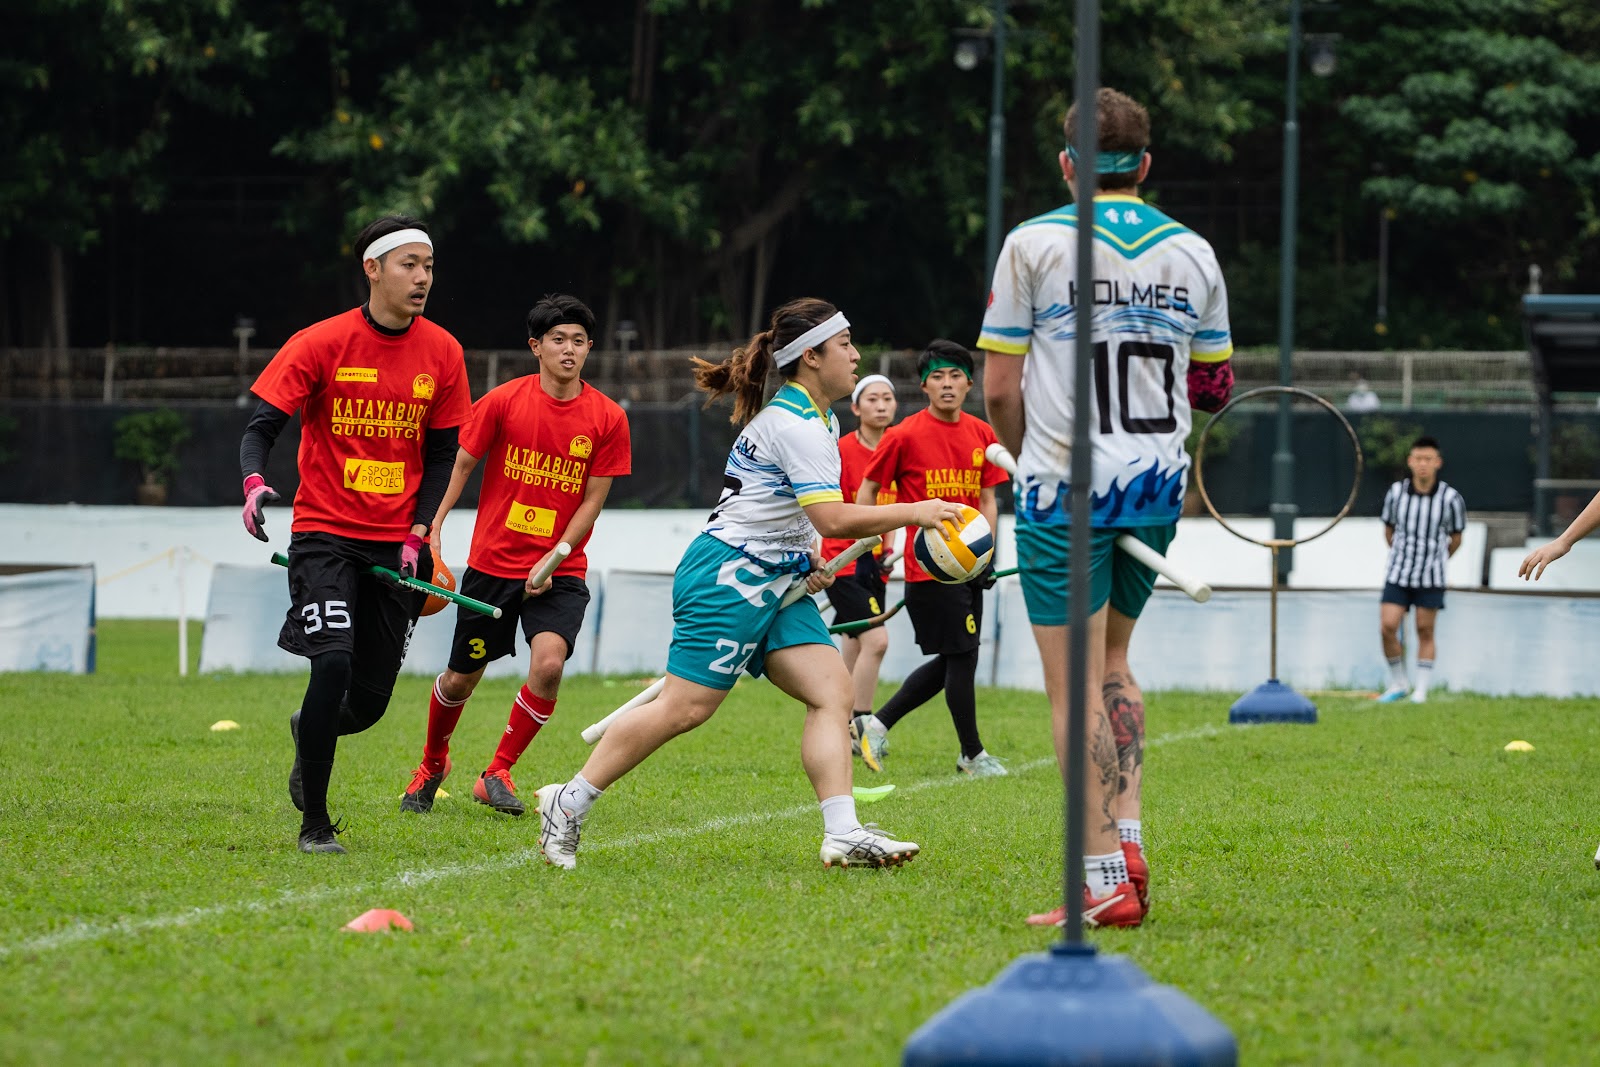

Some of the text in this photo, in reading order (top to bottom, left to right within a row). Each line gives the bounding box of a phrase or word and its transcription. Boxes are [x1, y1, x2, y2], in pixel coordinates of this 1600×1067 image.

[1104, 208, 1143, 225] 香港
[1092, 341, 1177, 434] 10
[506, 443, 586, 479] KATAYABURI
[361, 475, 402, 488] PROJECT
[504, 466, 581, 494] QUIDDITCH
[507, 520, 551, 534] SPORTS WORLD
[301, 600, 351, 635] 35
[965, 613, 977, 634] 6
[468, 638, 487, 660] 3
[708, 637, 758, 675] 22
